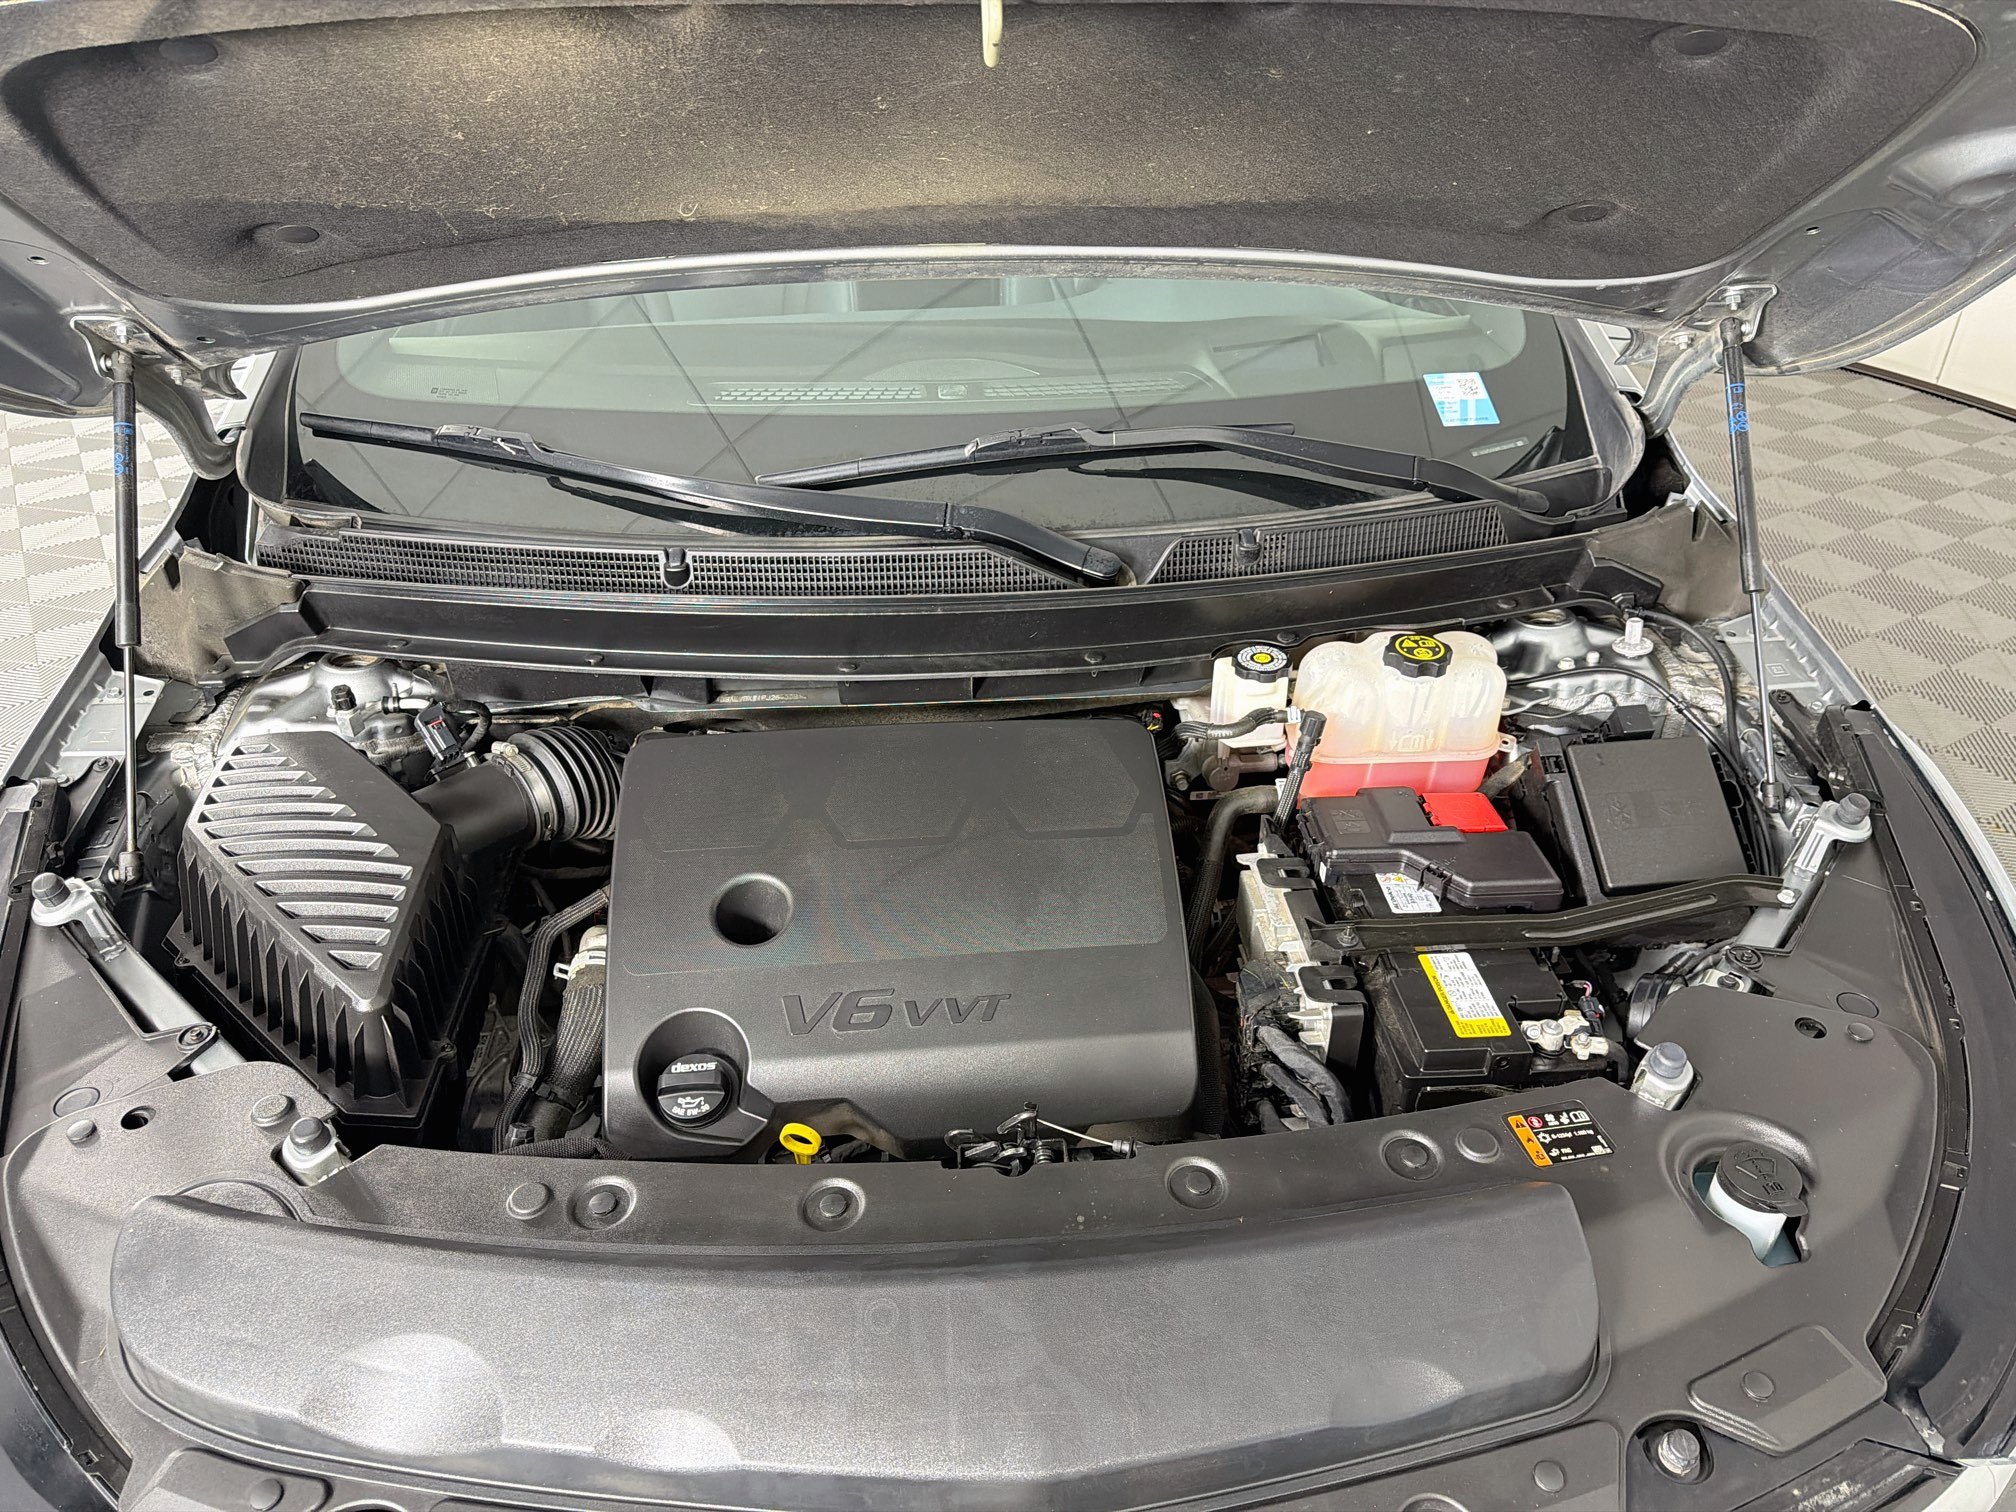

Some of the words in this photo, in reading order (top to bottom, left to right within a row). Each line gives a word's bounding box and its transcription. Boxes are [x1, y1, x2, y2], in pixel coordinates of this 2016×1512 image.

[782, 988, 894, 1036] V6
[904, 993, 1012, 1027] VVT
[671, 1061, 718, 1074] dexos
[671, 1105, 685, 1116] SAE
[686, 1103, 711, 1116] 5W-30
